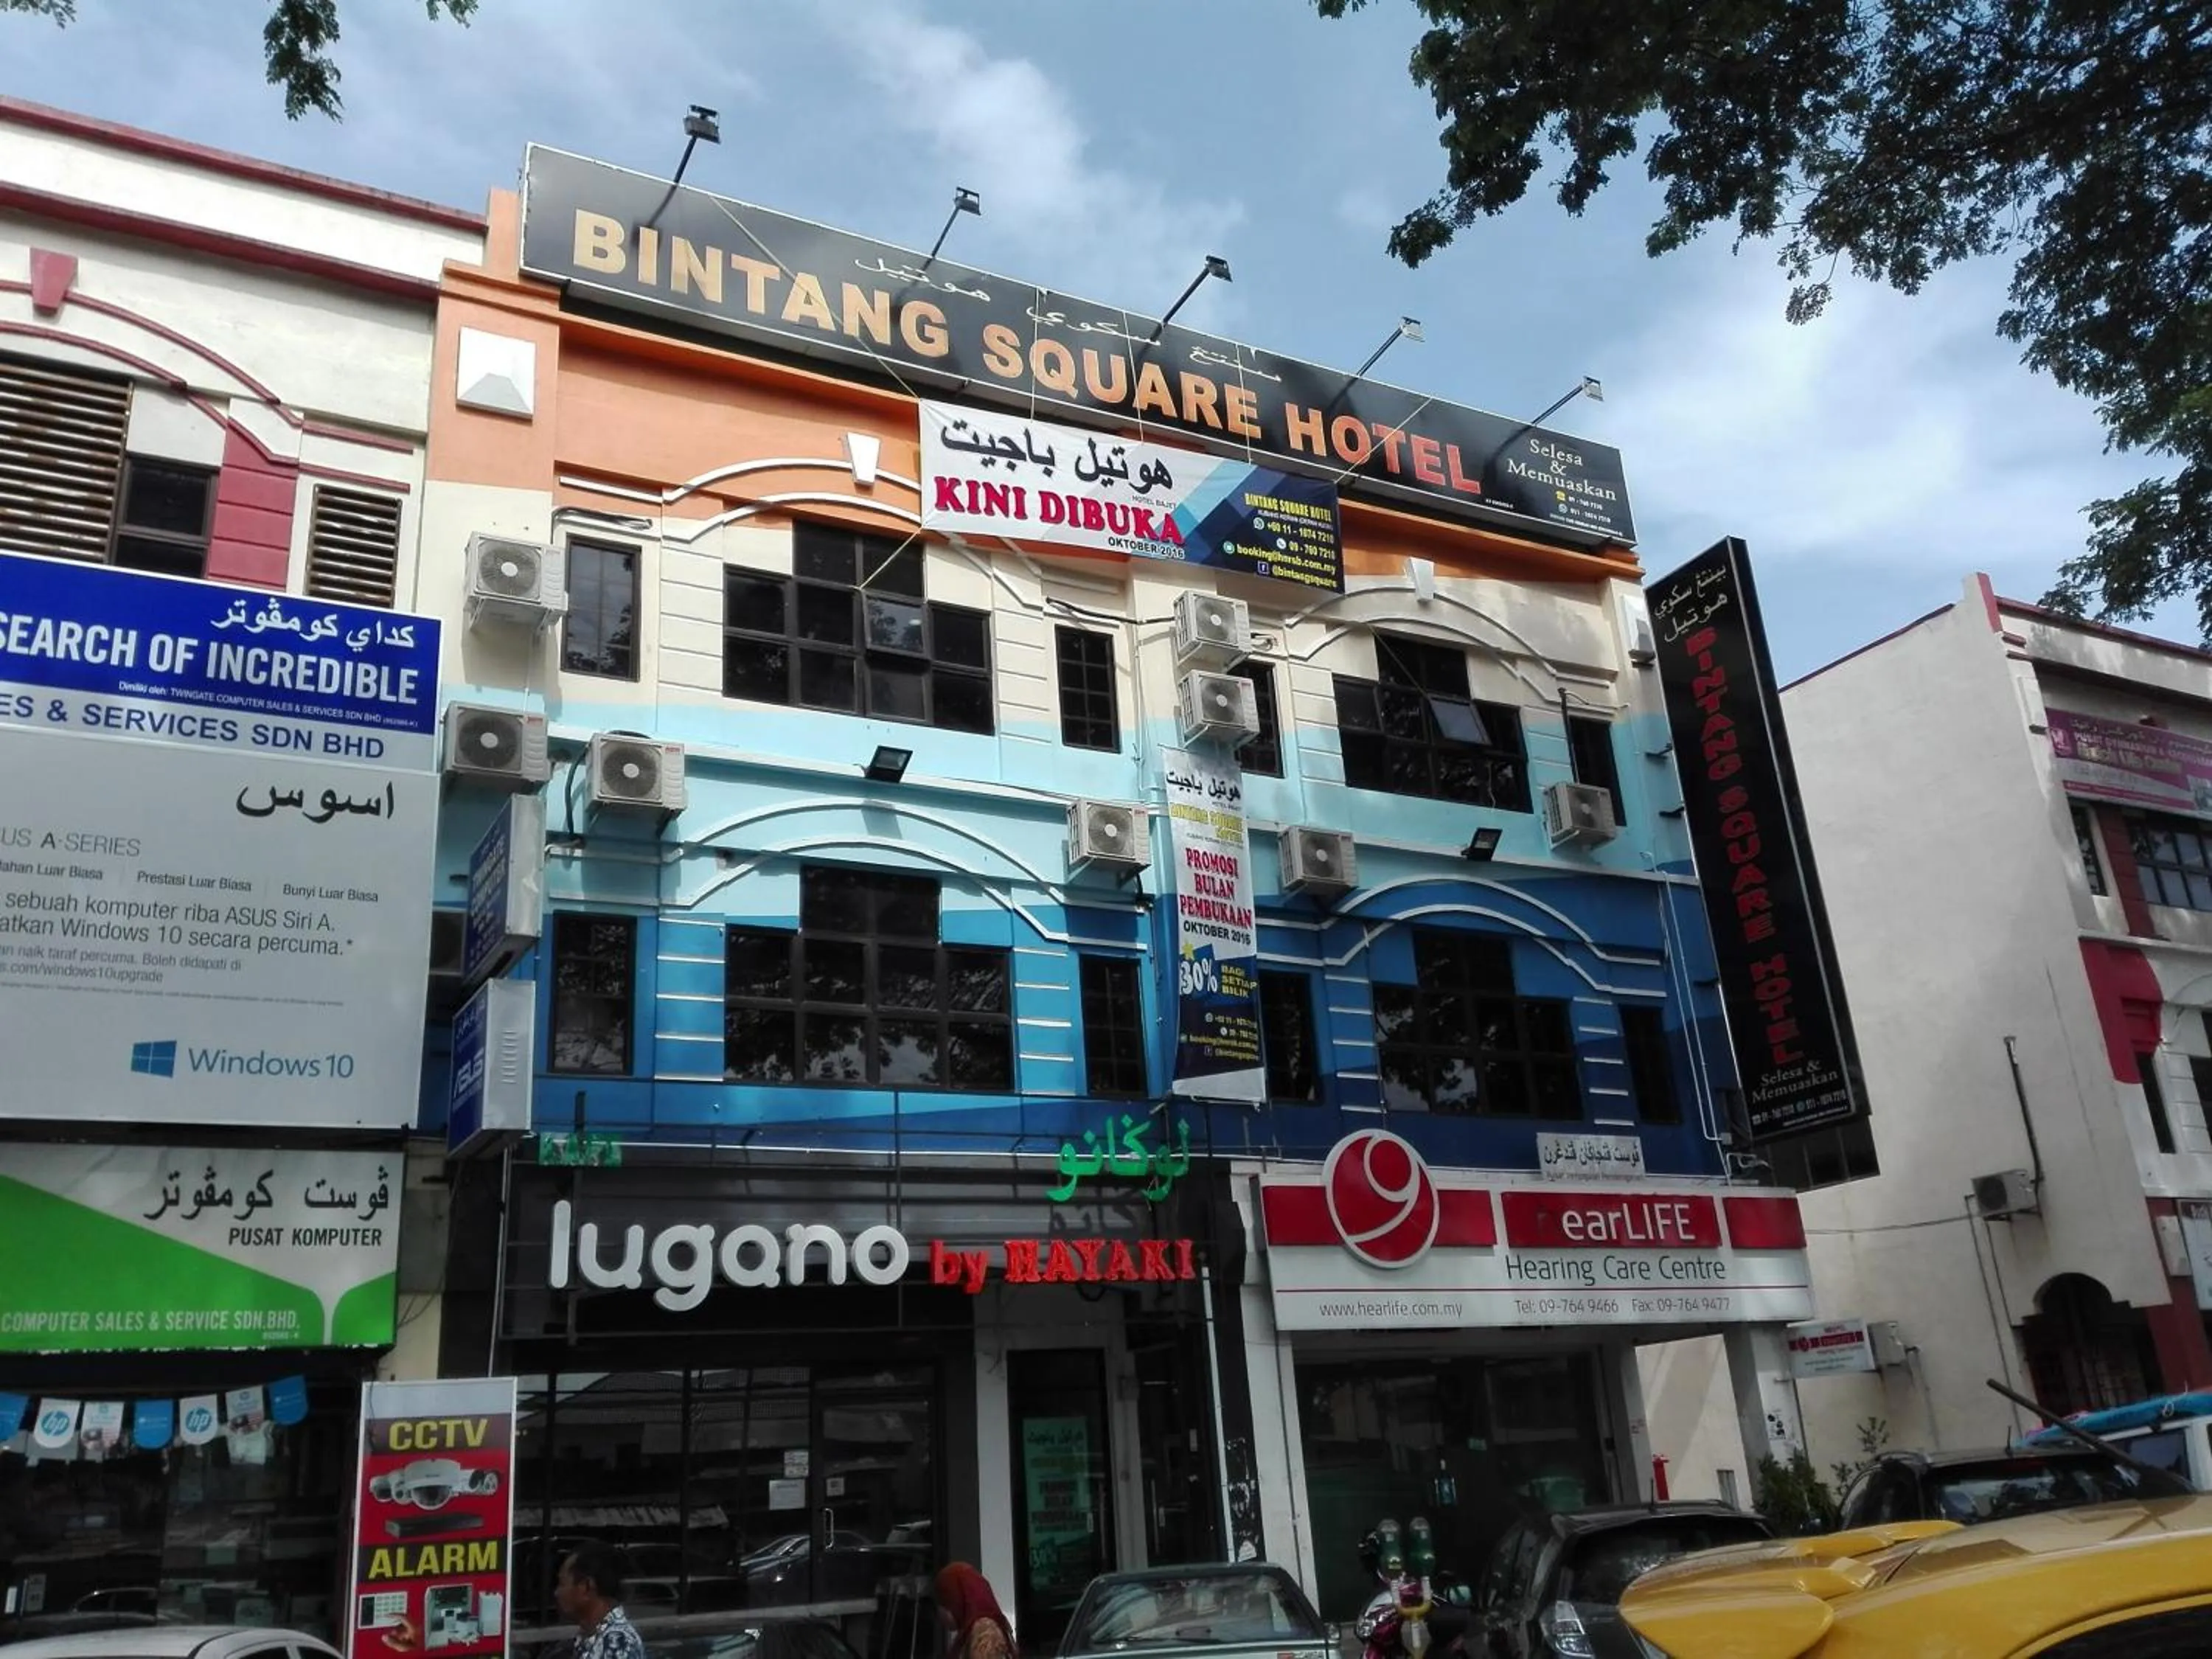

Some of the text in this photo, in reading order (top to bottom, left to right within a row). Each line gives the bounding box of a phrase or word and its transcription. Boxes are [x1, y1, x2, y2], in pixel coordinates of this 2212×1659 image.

[573, 208, 1481, 495] BINTANG SQUARE HOTEL
[942, 419, 1173, 493] هوتيل باجيت
[1529, 439, 1583, 466] Selesa
[1550, 460, 1567, 476] &
[1507, 458, 1616, 501] Memuaskan
[933, 475, 1186, 548] KINI DIBUKA
[1245, 493, 1279, 510] BINTANG
[1279, 499, 1309, 517] SQUARE
[1310, 505, 1332, 522] HOTEL
[1108, 536, 1185, 560] OKTOBER 2016
[1664, 594, 1728, 642] هوتيل
[347, 619, 414, 652] كداي
[148, 632, 199, 674] OF
[206, 641, 418, 706] INCREDIBLE
[216, 695, 265, 709] COMPUTER
[266, 701, 293, 712] SALES
[302, 706, 343, 719] SERVICES
[345, 710, 363, 721] SDN
[1685, 627, 1743, 782] BINTANG
[47, 699, 68, 722] &
[82, 703, 239, 742] SERVICES
[251, 723, 313, 752] SDN
[323, 732, 384, 759] BHD
[235, 779, 394, 824] اسوس
[1166, 771, 1241, 801] هوتيل باجيت
[37, 863, 66, 877] Luar
[69, 866, 103, 880] Biasa
[1186, 848, 1239, 879] PROMOSI
[1719, 784, 1776, 944] SQUARE
[137, 870, 252, 892] Prestasi Luar Biasa
[282, 883, 379, 902] Bunyi Luar Biasa
[1194, 873, 1236, 901] BULAN
[5, 891, 335, 932] sebuah komputer riba ASUS Siri A.
[1180, 894, 1252, 928] PEMBUKAAN
[61, 919, 150, 943] Windows
[158, 926, 183, 945] 10
[188, 931, 251, 950] secara
[1183, 919, 1229, 940] OKTOBER
[18, 945, 44, 959] naik
[49, 947, 77, 960] taraf
[142, 953, 176, 967] Boleh
[180, 955, 226, 970] didapati
[231, 961, 241, 971] di
[1179, 959, 1217, 996] 30%
[1221, 974, 1258, 990] SETIAP
[1221, 984, 1248, 998] BILIK
[1750, 953, 1805, 1065] HOTEL
[189, 1047, 355, 1078] Windows 10
[1760, 1059, 1823, 1088] Selesa &
[1751, 1071, 1839, 1105] Memuaskan
[228, 1226, 382, 1248] PUSAT KOMPUTER
[1562, 1203, 1695, 1241] earLIFE
[549, 1200, 1196, 1312] lugano by HAYAKI
[1506, 1255, 1725, 1286] Hearing Care Centre
[1, 1311, 90, 1332] COMPUTER
[95, 1311, 145, 1332] SALES
[150, 1312, 159, 1331] &
[165, 1310, 229, 1331] SERVICE
[1319, 1300, 1463, 1319] www.hearlife.com.my
[1514, 1297, 1730, 1314] Tel: 09-764 9466 Fax: 09-764 9477
[44, 1411, 69, 1436] hp
[187, 1408, 212, 1432] hp
[389, 1418, 487, 1451] CCTV
[368, 1540, 498, 1579] ALARM
